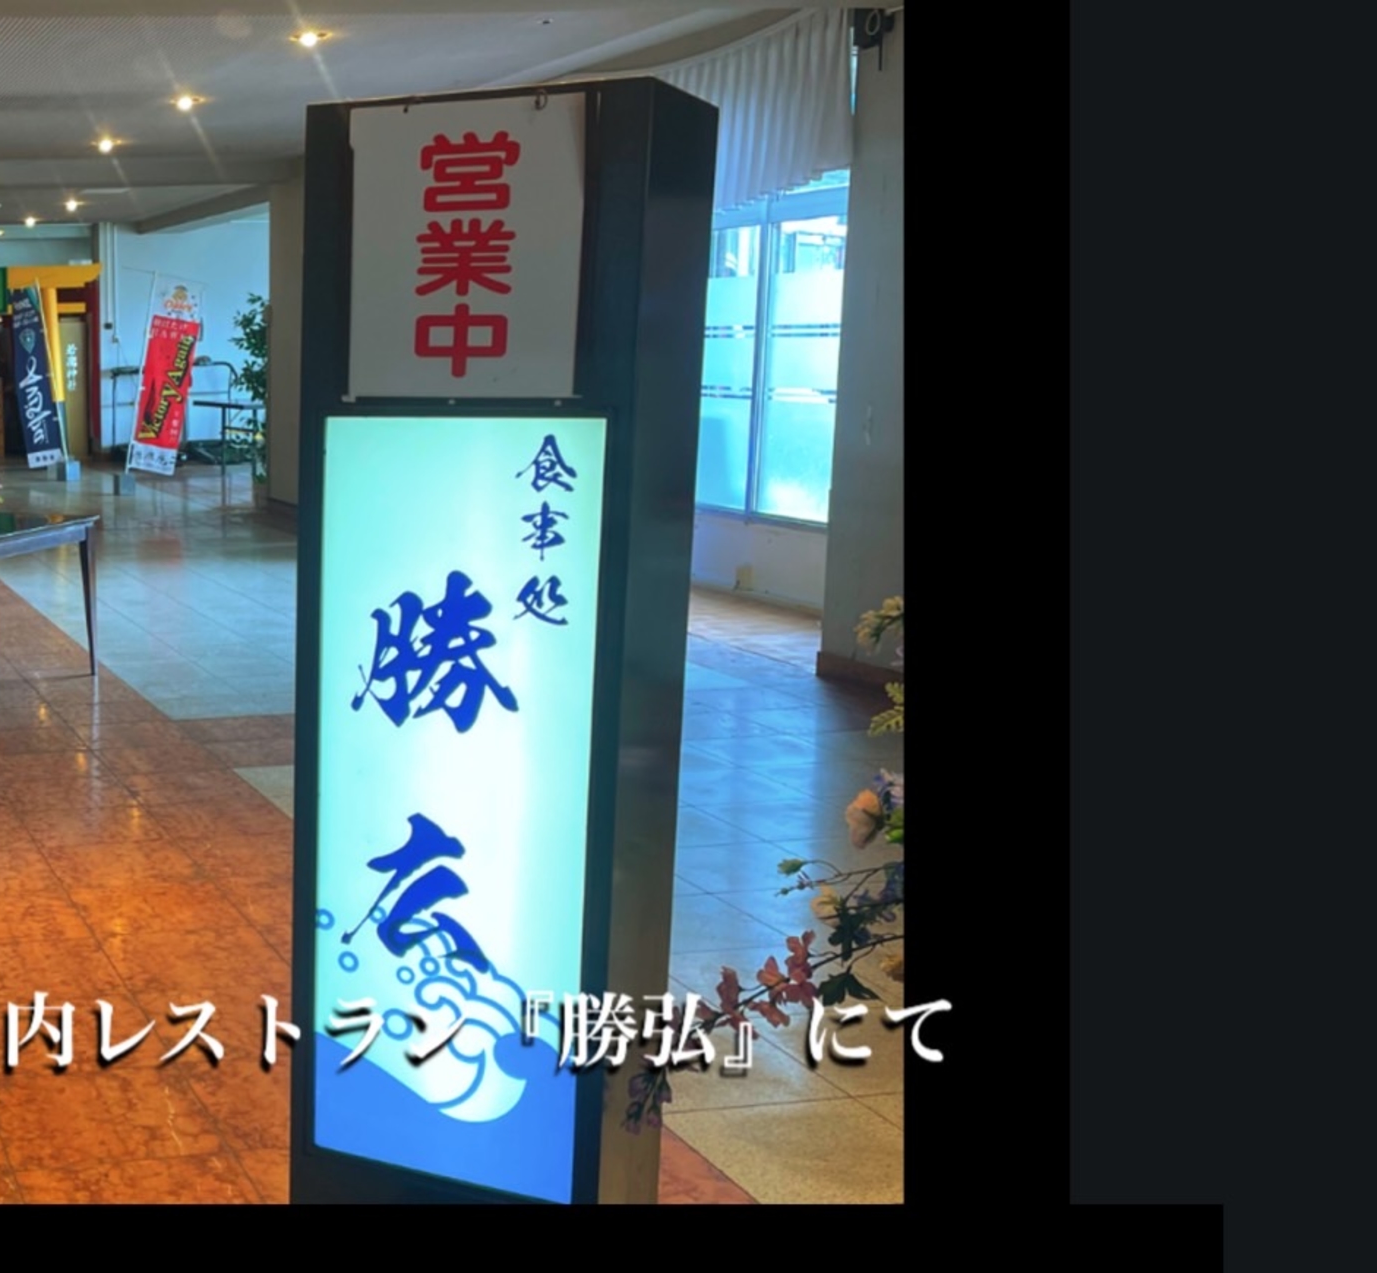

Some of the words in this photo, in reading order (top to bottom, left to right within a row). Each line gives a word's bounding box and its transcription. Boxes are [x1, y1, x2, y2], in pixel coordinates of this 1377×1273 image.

[413, 131, 521, 379] 営業中
[513, 434, 577, 627] 食事処
